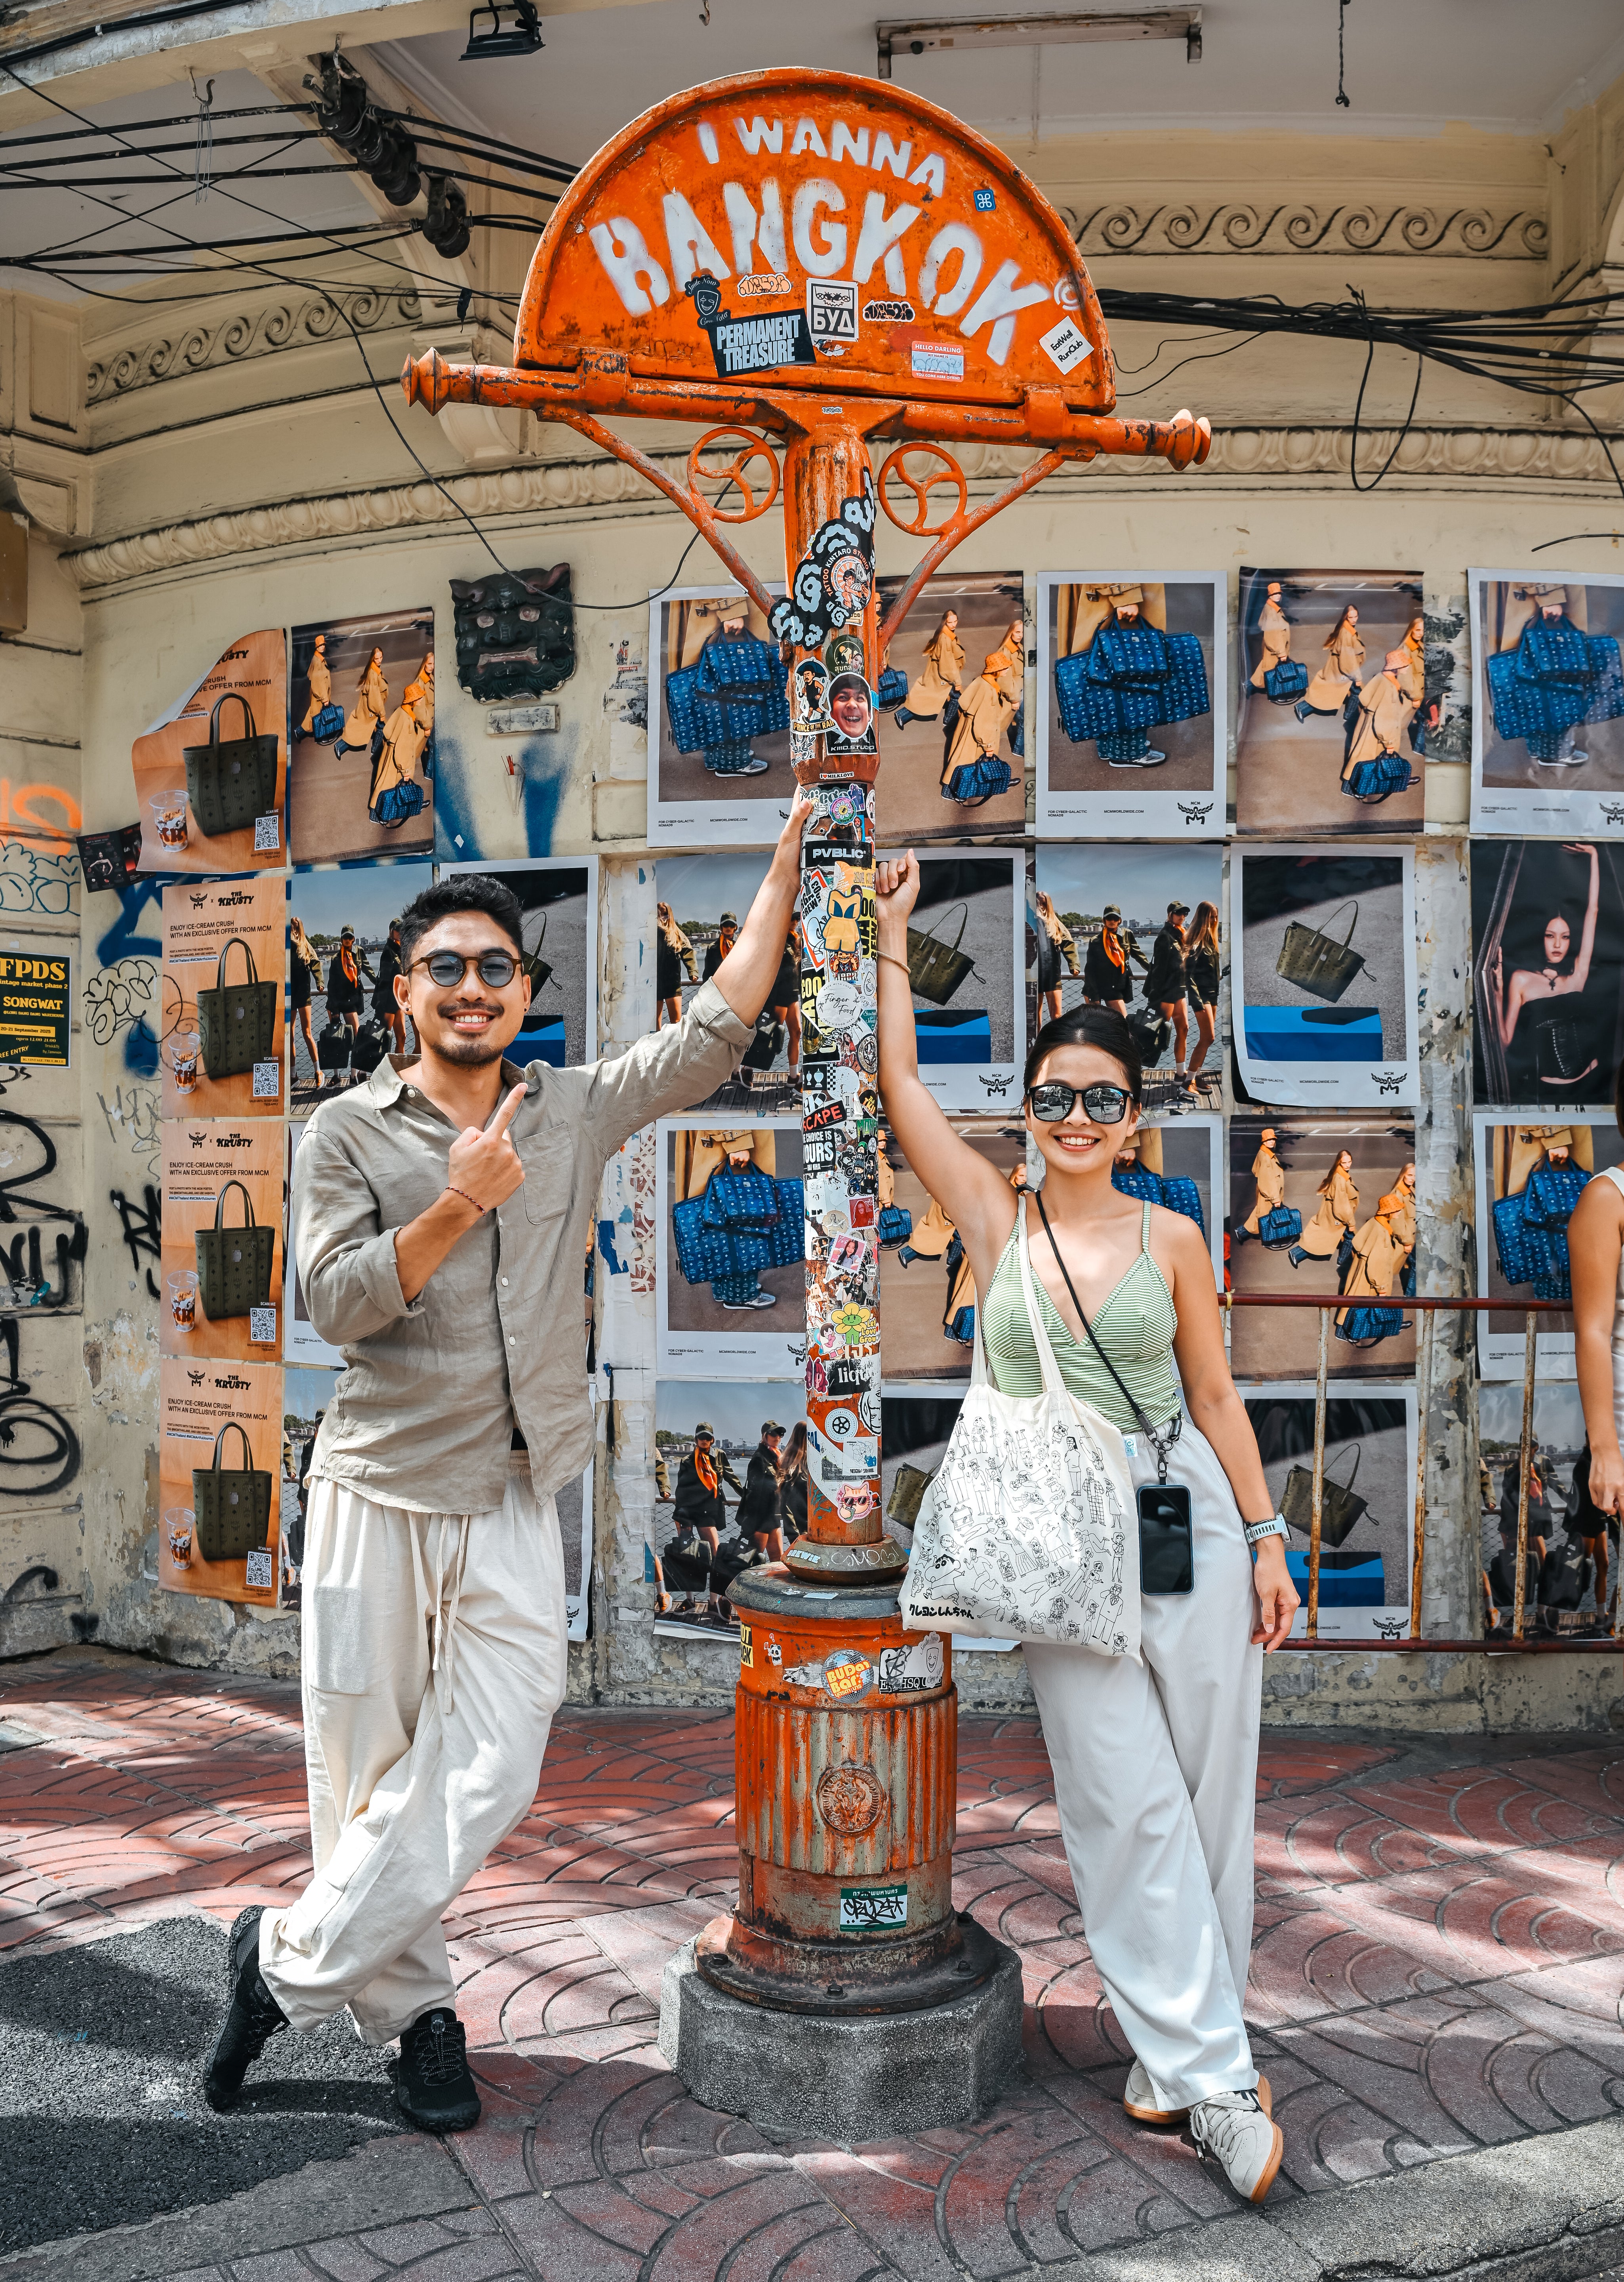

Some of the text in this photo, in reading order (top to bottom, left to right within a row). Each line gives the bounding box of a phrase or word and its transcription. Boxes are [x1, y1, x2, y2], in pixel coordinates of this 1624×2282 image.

[698, 116, 947, 198] I WANNA
[589, 177, 1052, 367] BANGKOK
[688, 278, 717, 294] Smile Now
[813, 307, 854, 334] БУД
[717, 314, 801, 350] PERMANENT
[1050, 329, 1073, 351] EatWell
[723, 338, 795, 371] TREASURE
[1058, 340, 1083, 363] RunClub
[823, 548, 869, 597] TATTOO KINTARO STUDIO
[216, 650, 249, 666] USTY
[793, 723, 810, 732] PRINCE
[218, 896, 254, 906] KRUSTY
[3, 996, 63, 1010] SONGWAT
[824, 993, 850, 1008] Finger
[837, 1005, 857, 1016] Food
[11, 1045, 29, 1055] ENTRY
[216, 1138, 253, 1147] KRUSTY
[867, 1318, 876, 1327] Let
[859, 1335, 876, 1343] Grow
[862, 1327, 876, 1336] Love
[215, 1379, 252, 1390] KRUSTY
[189, 1408, 217, 1416] EXCLUSIVE
[909, 1603, 974, 1620] クレヨンしんちゃん
[920, 1638, 930, 1655] Smile
[830, 1675, 860, 1694] Bar
